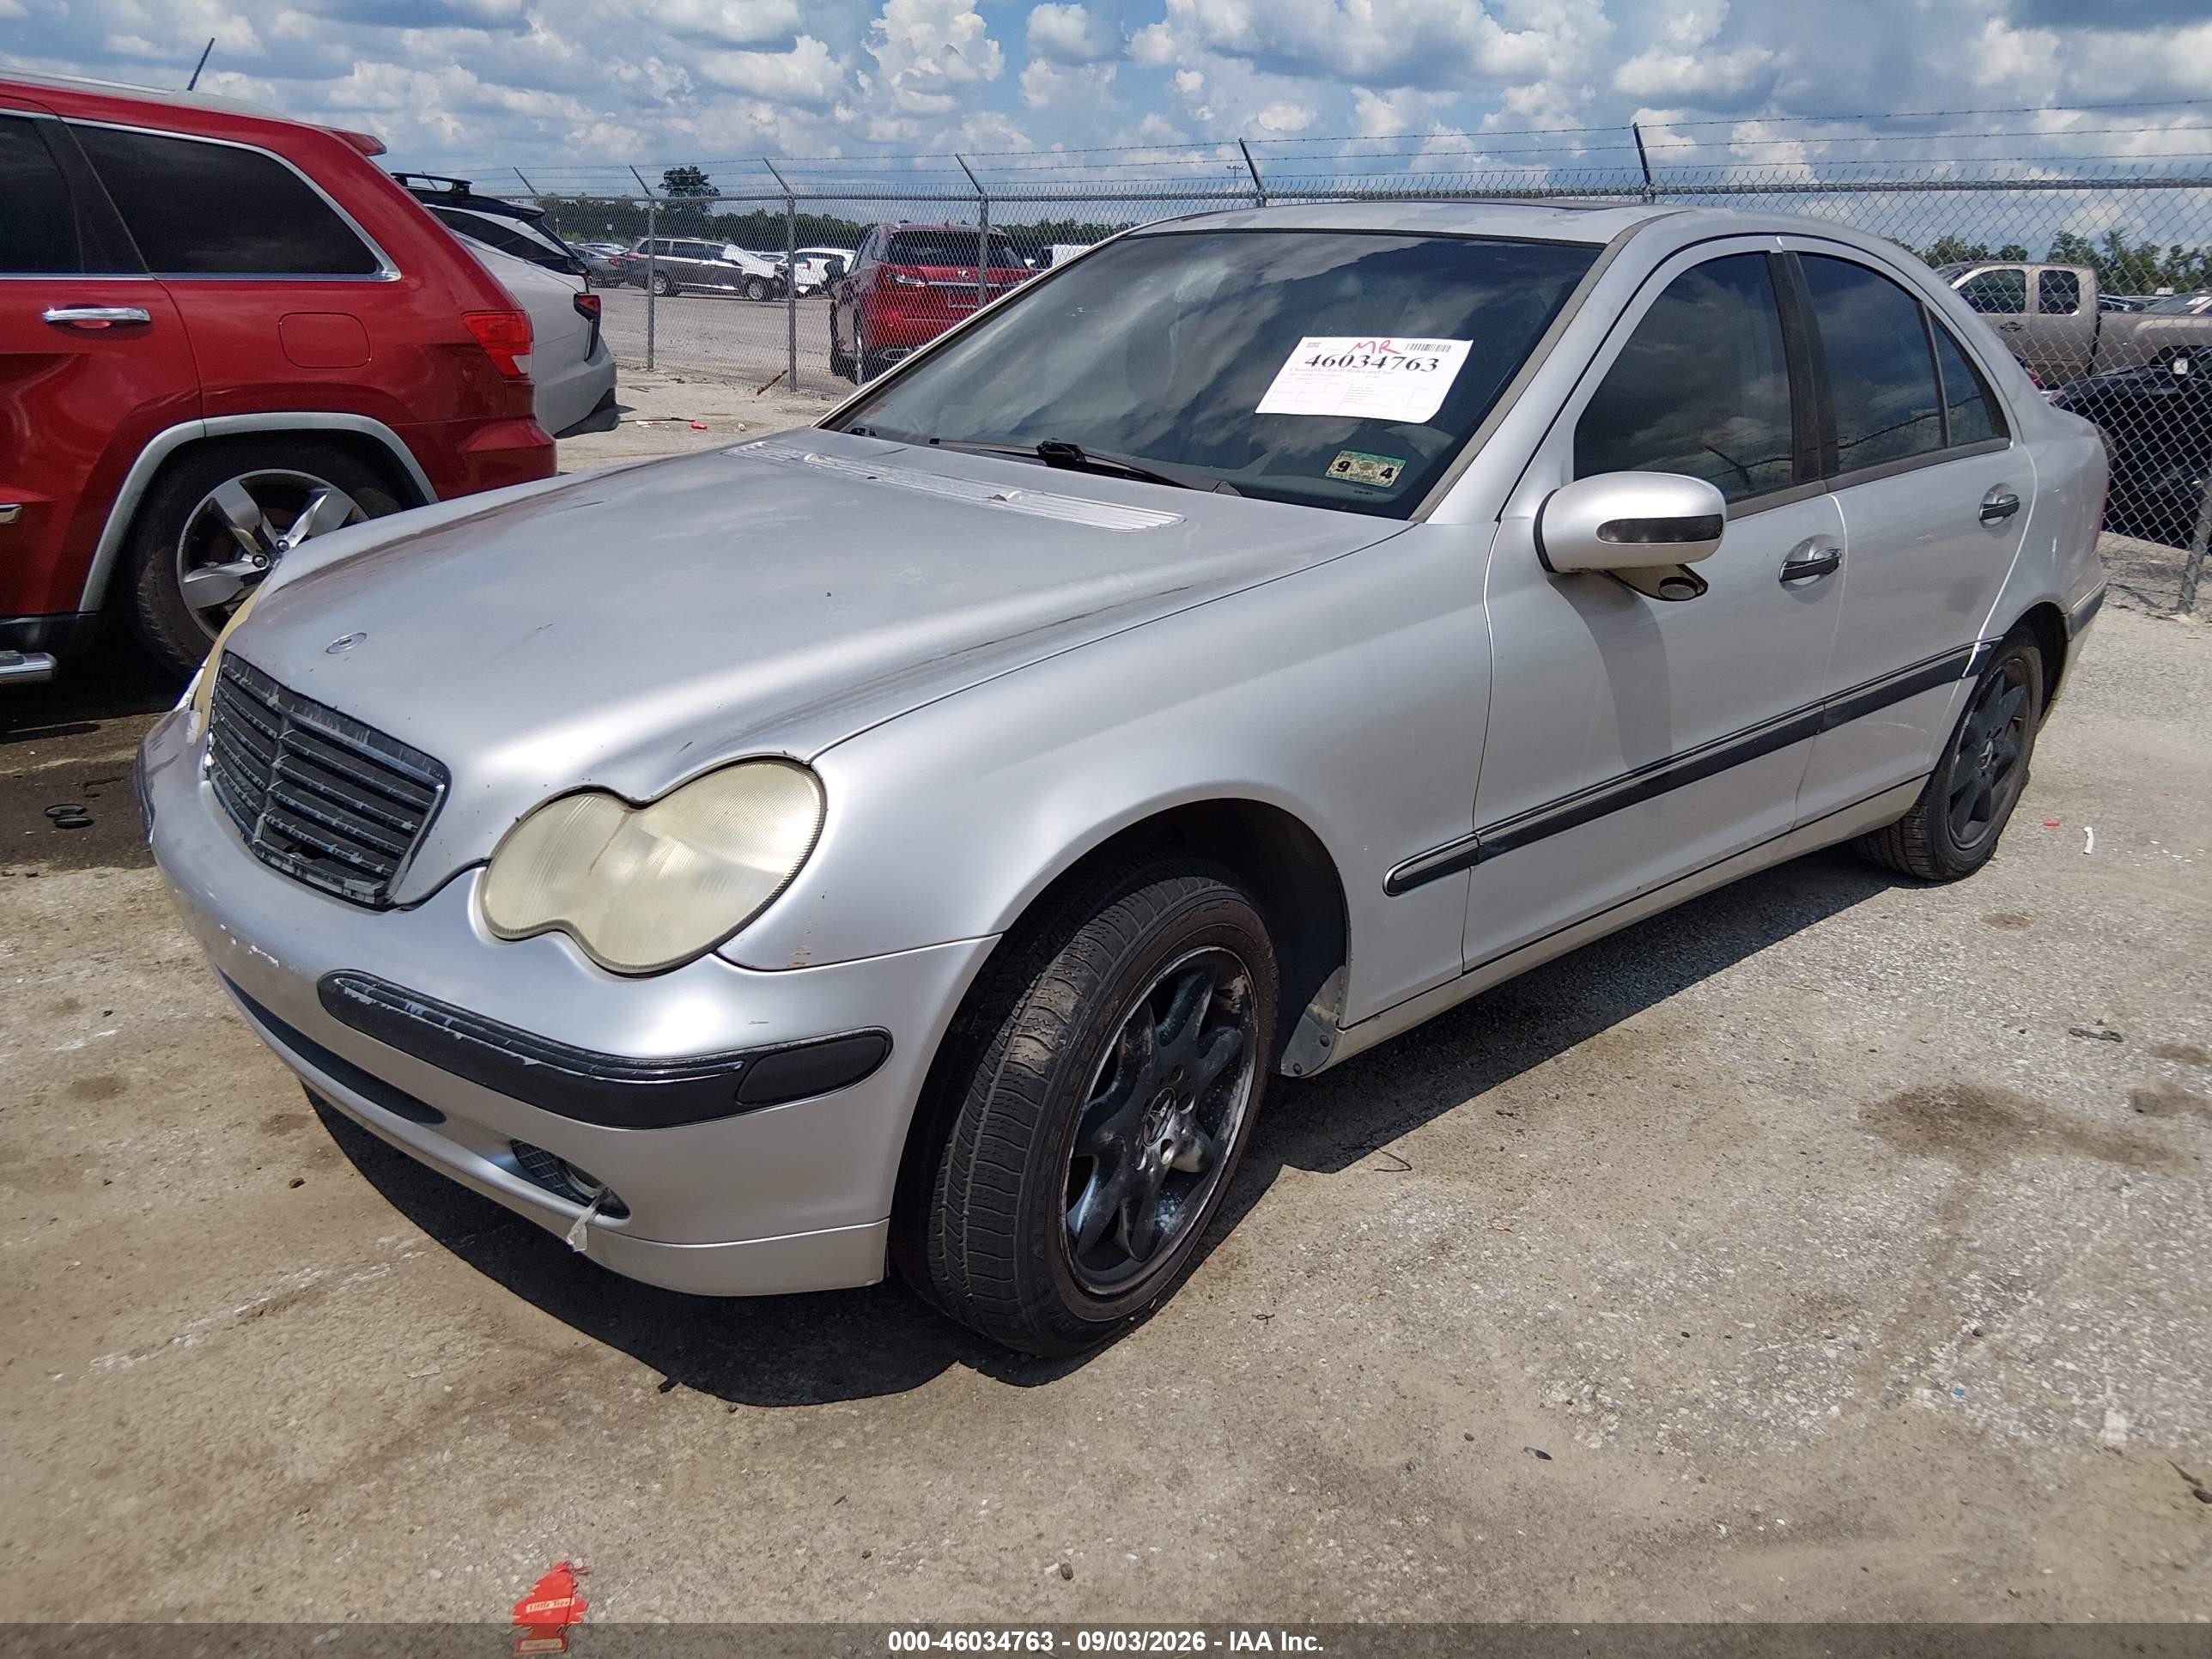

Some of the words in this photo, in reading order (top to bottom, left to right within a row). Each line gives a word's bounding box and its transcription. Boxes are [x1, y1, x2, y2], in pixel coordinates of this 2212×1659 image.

[1346, 339, 1401, 355] MR
[1304, 354, 1439, 373] 46034763
[1335, 460, 1351, 472] 9
[1380, 467, 1395, 479] 4
